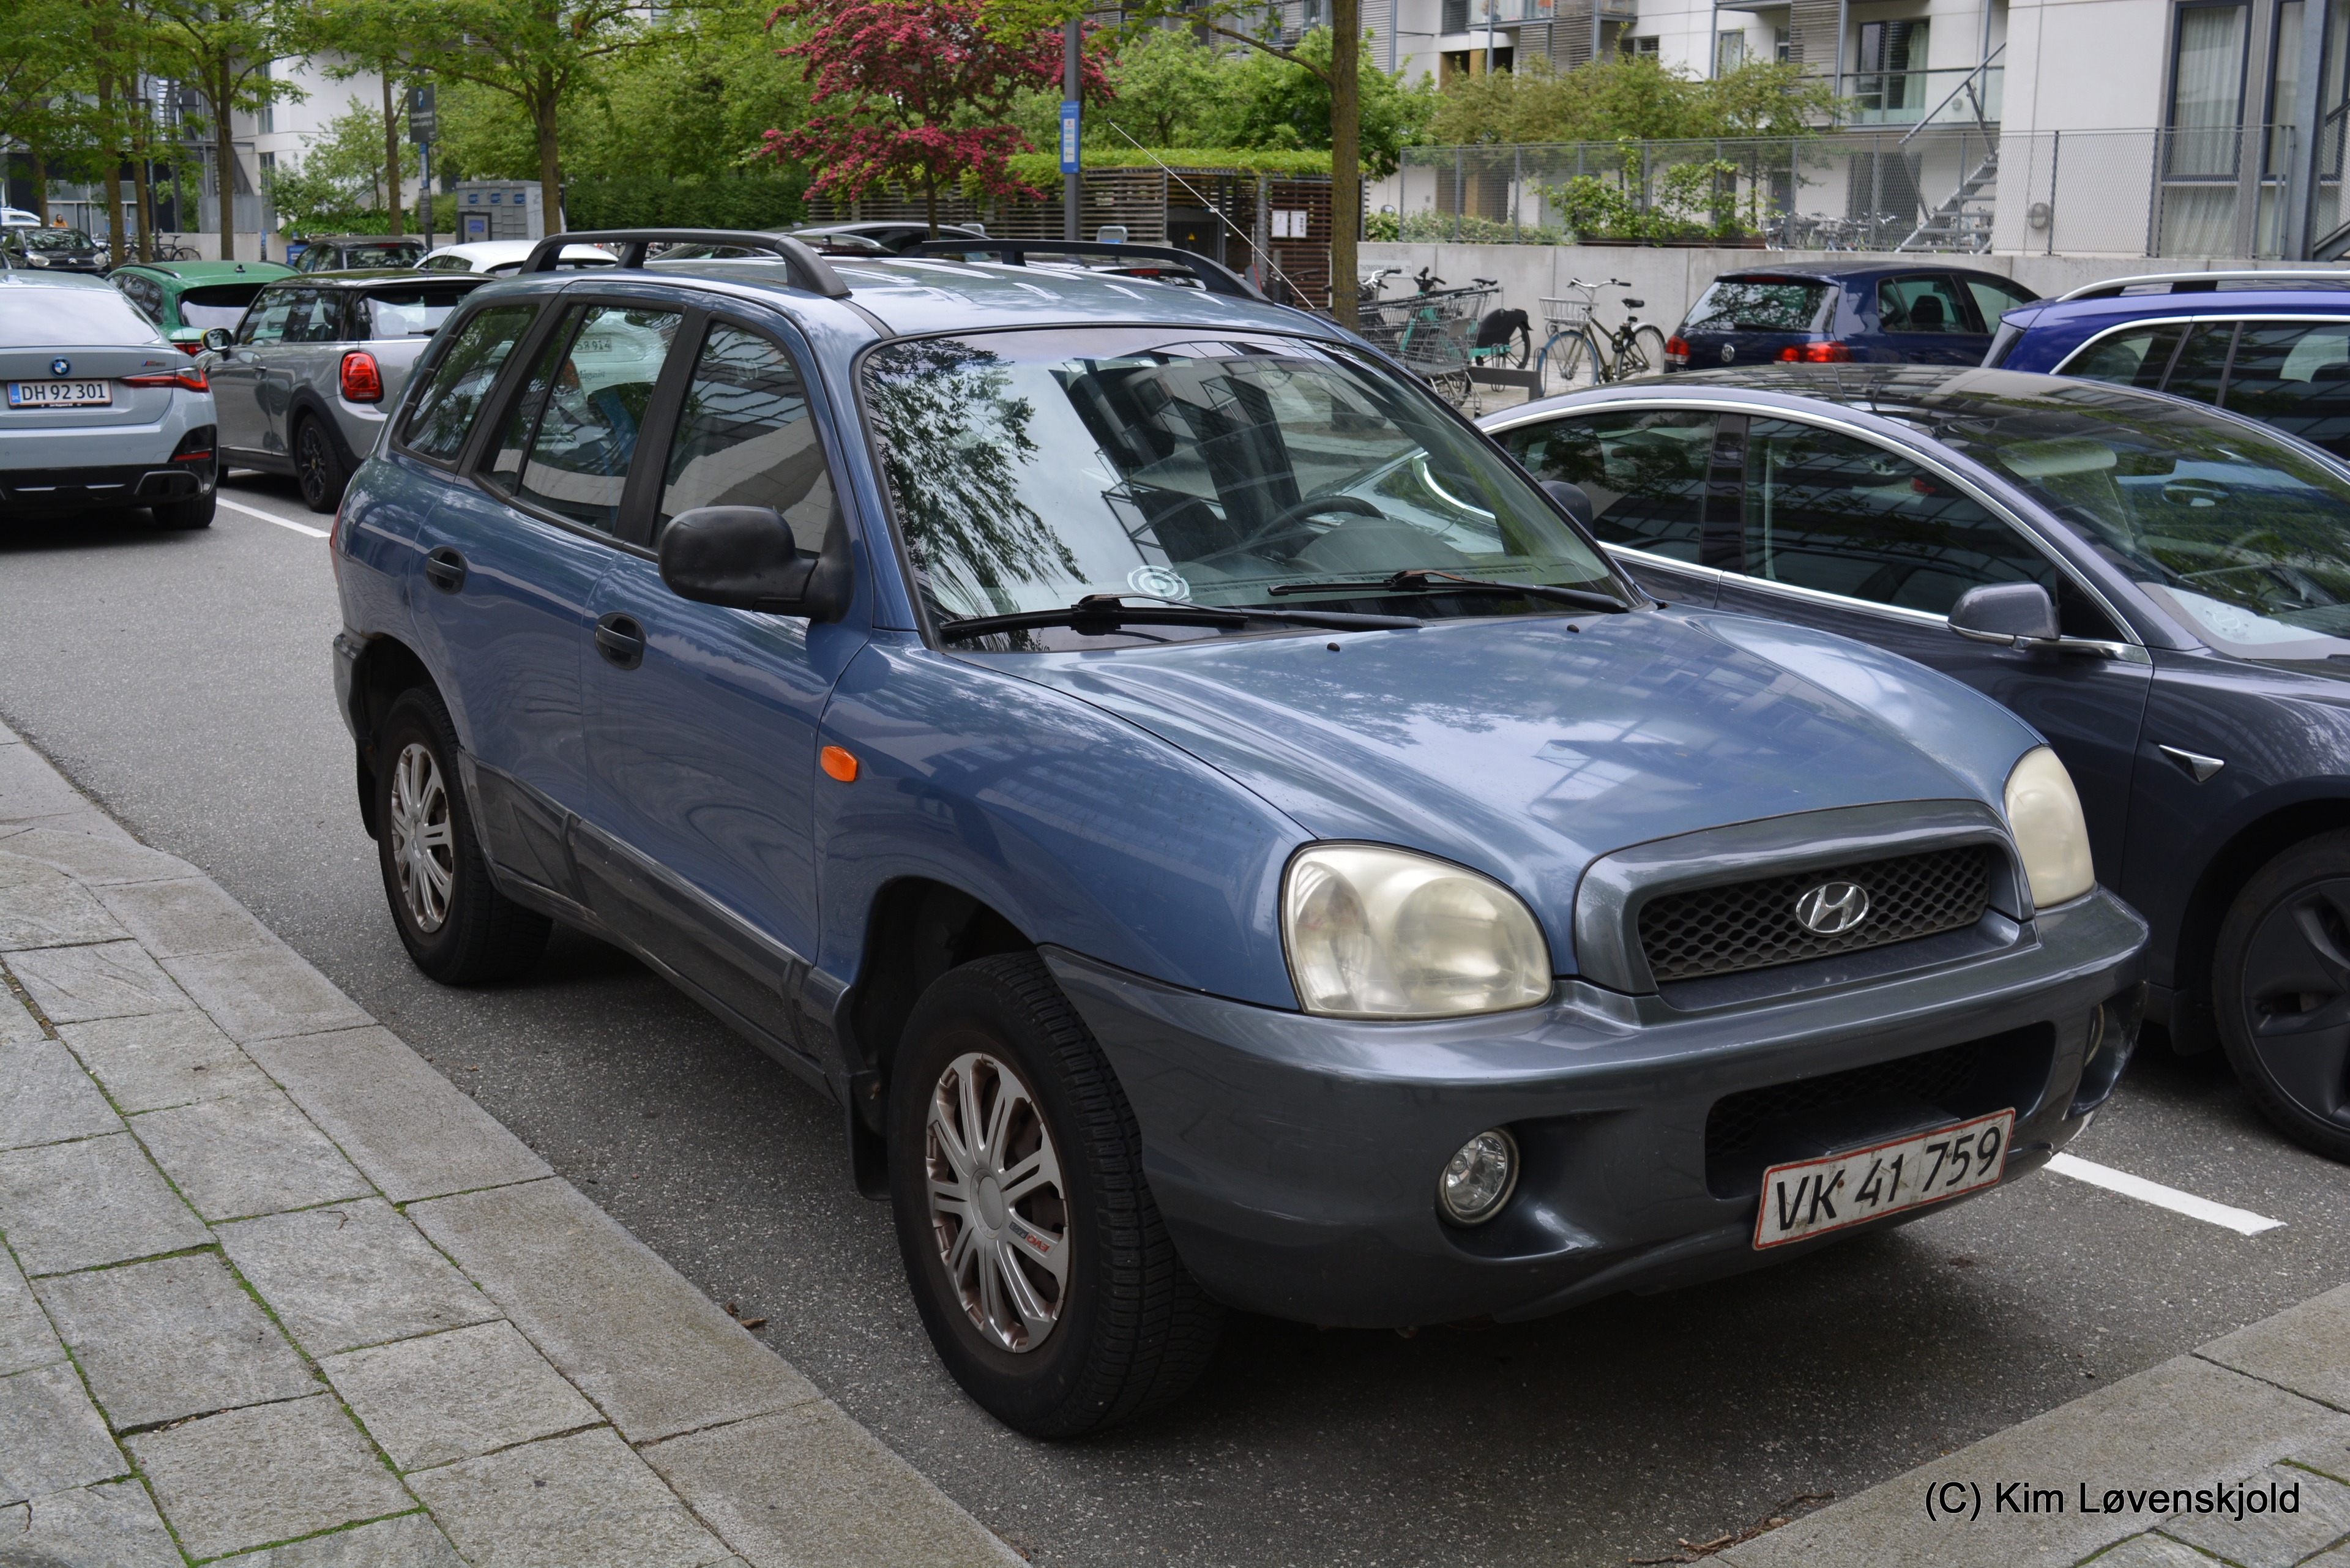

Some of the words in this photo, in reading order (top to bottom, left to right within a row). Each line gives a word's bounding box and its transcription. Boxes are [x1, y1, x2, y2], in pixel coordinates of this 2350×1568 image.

[21, 386, 46, 401] DH
[50, 384, 72, 400] 92
[75, 383, 106, 399] 301
[1777, 1169, 1846, 1231] VK
[1854, 1154, 1904, 1207] 41
[1922, 1126, 2001, 1192] 759
[1010, 1223, 1027, 1238] RACE
[1026, 1234, 1050, 1252] EVO
